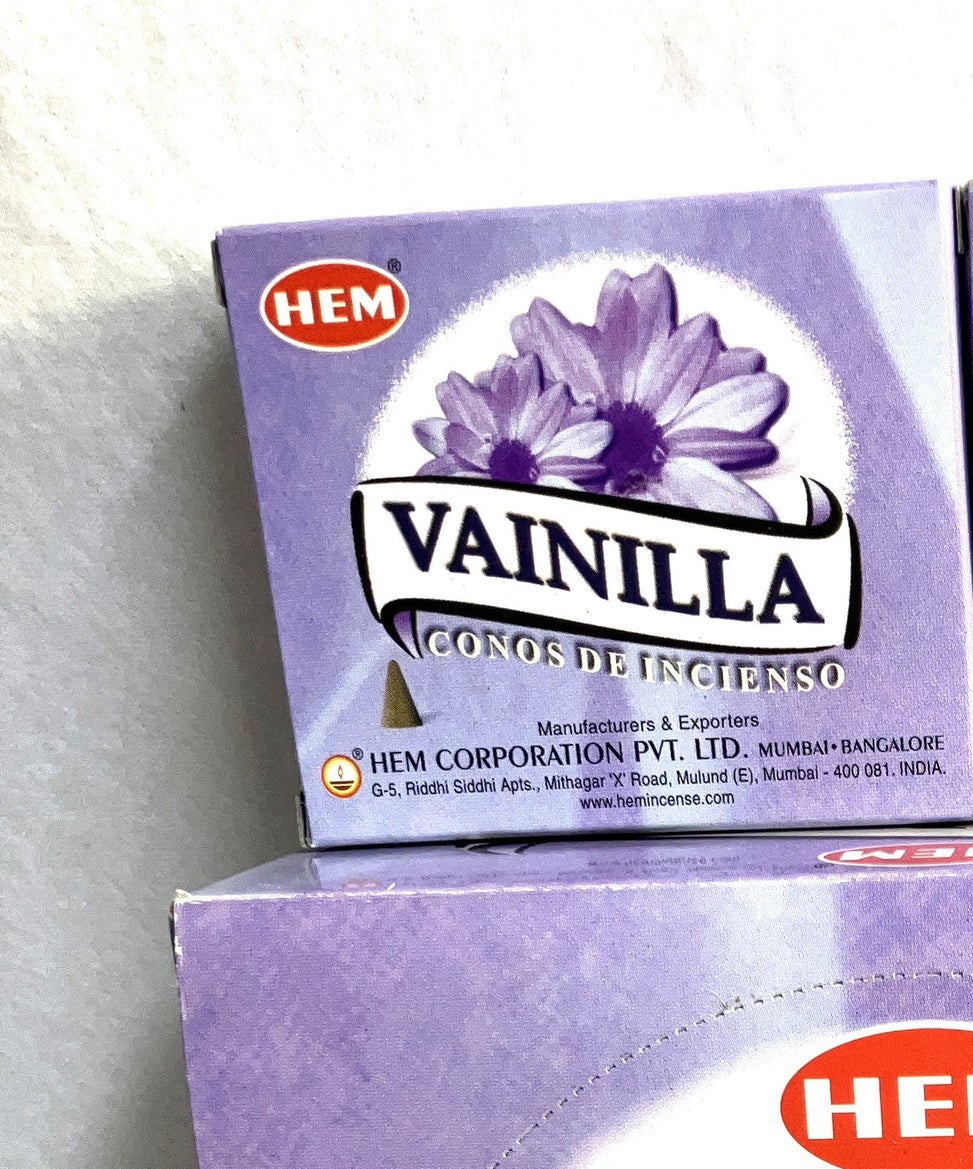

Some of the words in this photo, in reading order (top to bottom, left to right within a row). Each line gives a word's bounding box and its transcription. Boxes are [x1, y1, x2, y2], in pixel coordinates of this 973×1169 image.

[273, 284, 396, 327] HEM
[383, 500, 826, 625] VAINILLA
[426, 629, 566, 670] CONOS
[577, 646, 630, 681] DE
[640, 655, 846, 694] INCIENSO
[537, 719, 656, 736] Manufacturers
[661, 716, 673, 731] &
[678, 714, 759, 733] Exporters
[370, 750, 427, 774] HEM
[435, 740, 624, 771] CORPORATION
[633, 739, 684, 763] PVT.
[694, 736, 749, 761] LTD.
[841, 735, 945, 755] BANGALORE
[371, 783, 402, 798] G-5,
[405, 780, 449, 796] Riddhi
[453, 777, 497, 794] Siddhi
[501, 777, 541, 795] Apts.,
[544, 774, 606, 793] Mithagar
[630, 770, 673, 788] Road,
[676, 767, 728, 785] Mulund
[732, 767, 759, 786] (E),
[762, 764, 819, 782] Mumbai
[833, 763, 860, 779] 400
[899, 759, 947, 776] INDIA.
[579, 791, 735, 810] www.hemincense.com
